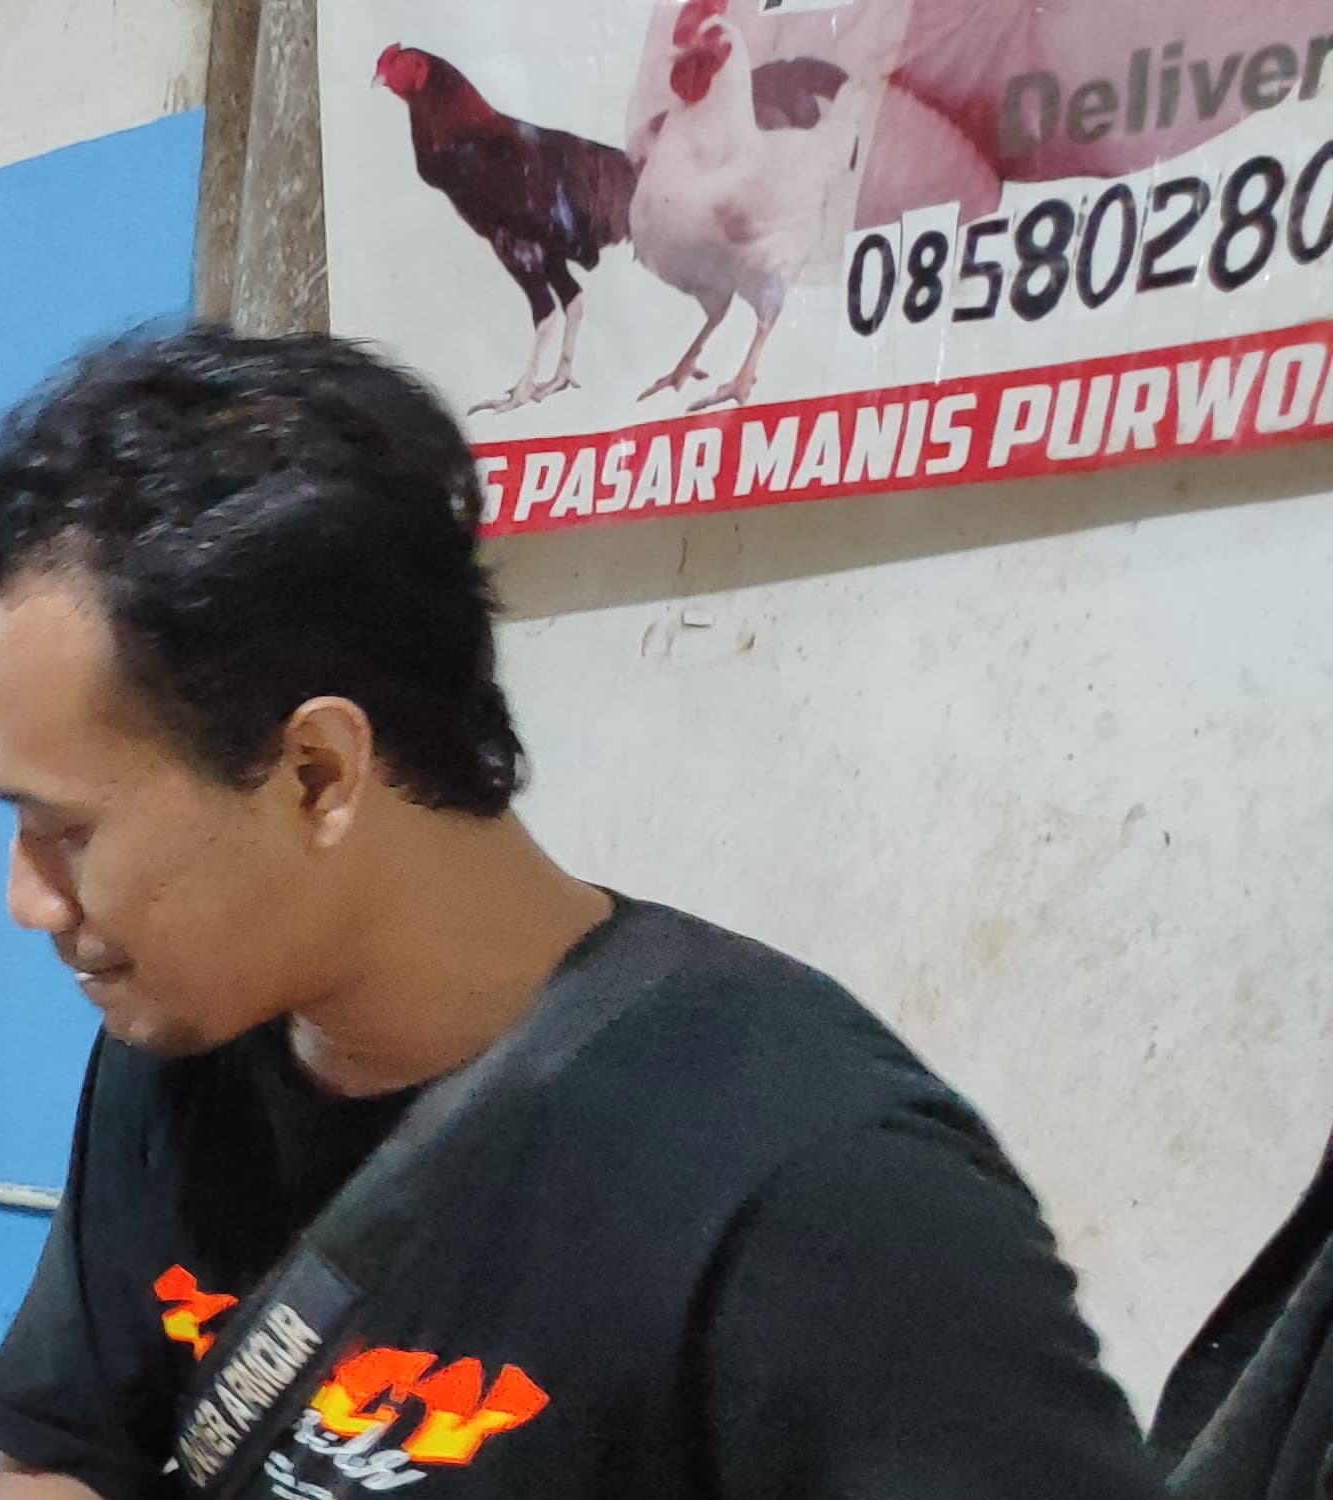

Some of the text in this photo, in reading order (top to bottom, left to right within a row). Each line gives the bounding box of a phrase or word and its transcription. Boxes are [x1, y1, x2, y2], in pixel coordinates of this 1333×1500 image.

[997, 30, 1333, 161] Deliver
[847, 140, 1333, 336] 08580280
[513, 427, 724, 522] PASAR
[732, 394, 978, 497] MANIS
[214, 1301, 324, 1433] ARMOUR
